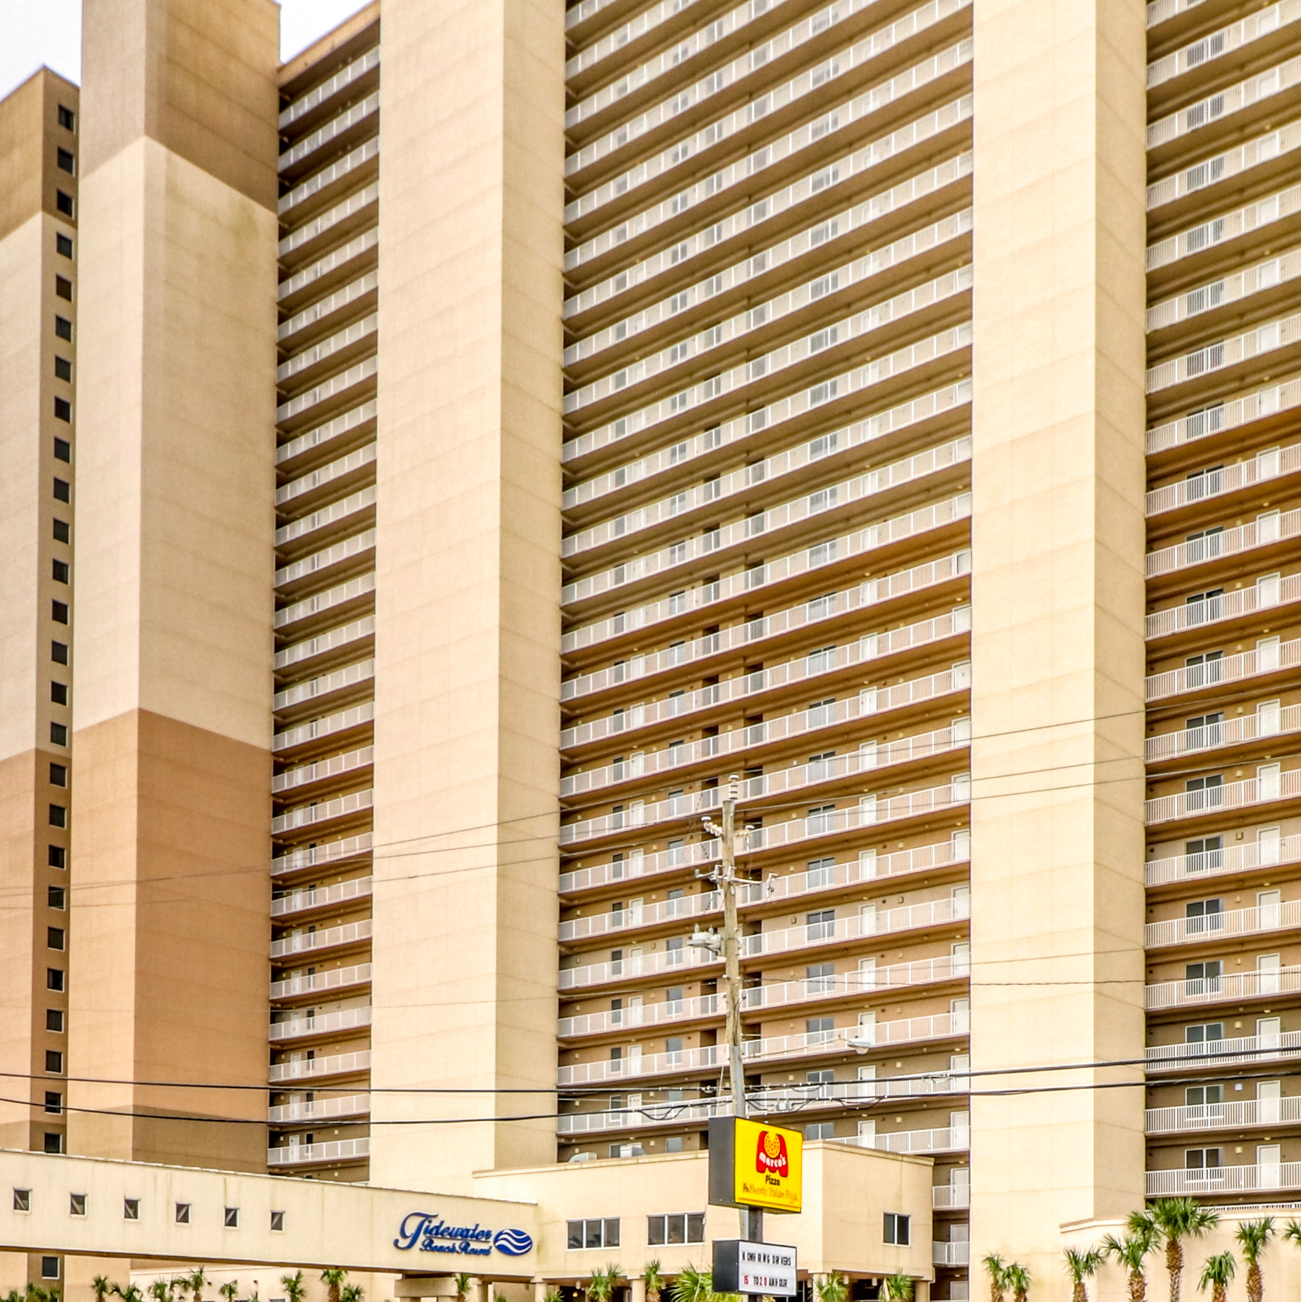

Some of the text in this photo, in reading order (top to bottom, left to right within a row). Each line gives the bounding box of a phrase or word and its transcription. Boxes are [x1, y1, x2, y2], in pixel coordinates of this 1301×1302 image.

[765, 1174, 780, 1186] Pizza
[393, 1212, 492, 1250] Tidewater
[420, 1238, 456, 1253] Beach
[753, 1276, 759, 1285] TO
